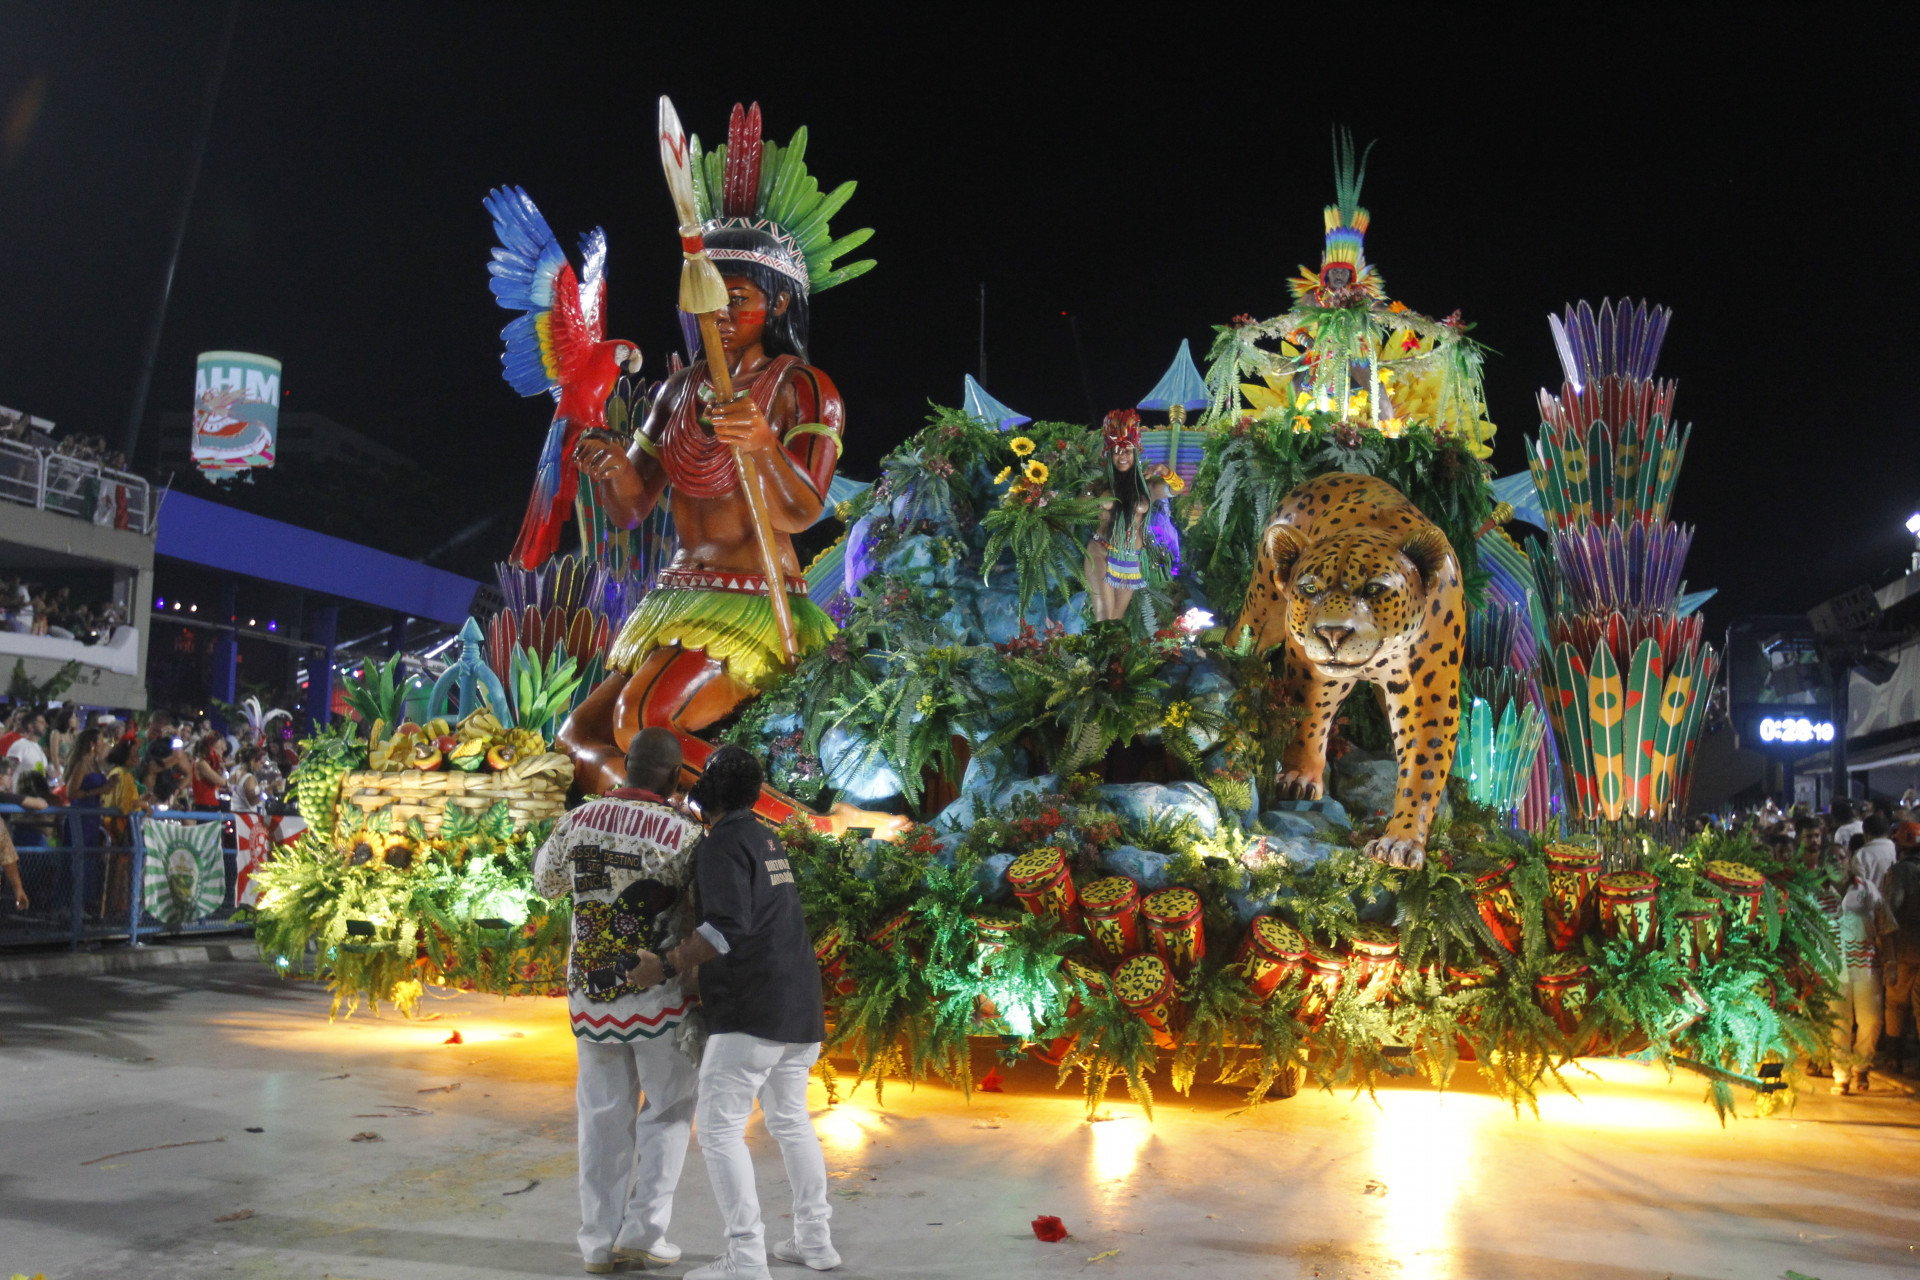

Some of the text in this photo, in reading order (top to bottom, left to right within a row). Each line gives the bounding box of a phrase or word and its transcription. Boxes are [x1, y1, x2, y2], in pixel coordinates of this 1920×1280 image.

[570, 847, 639, 867] OSSO DESTINO
[587, 863, 601, 872] SER
